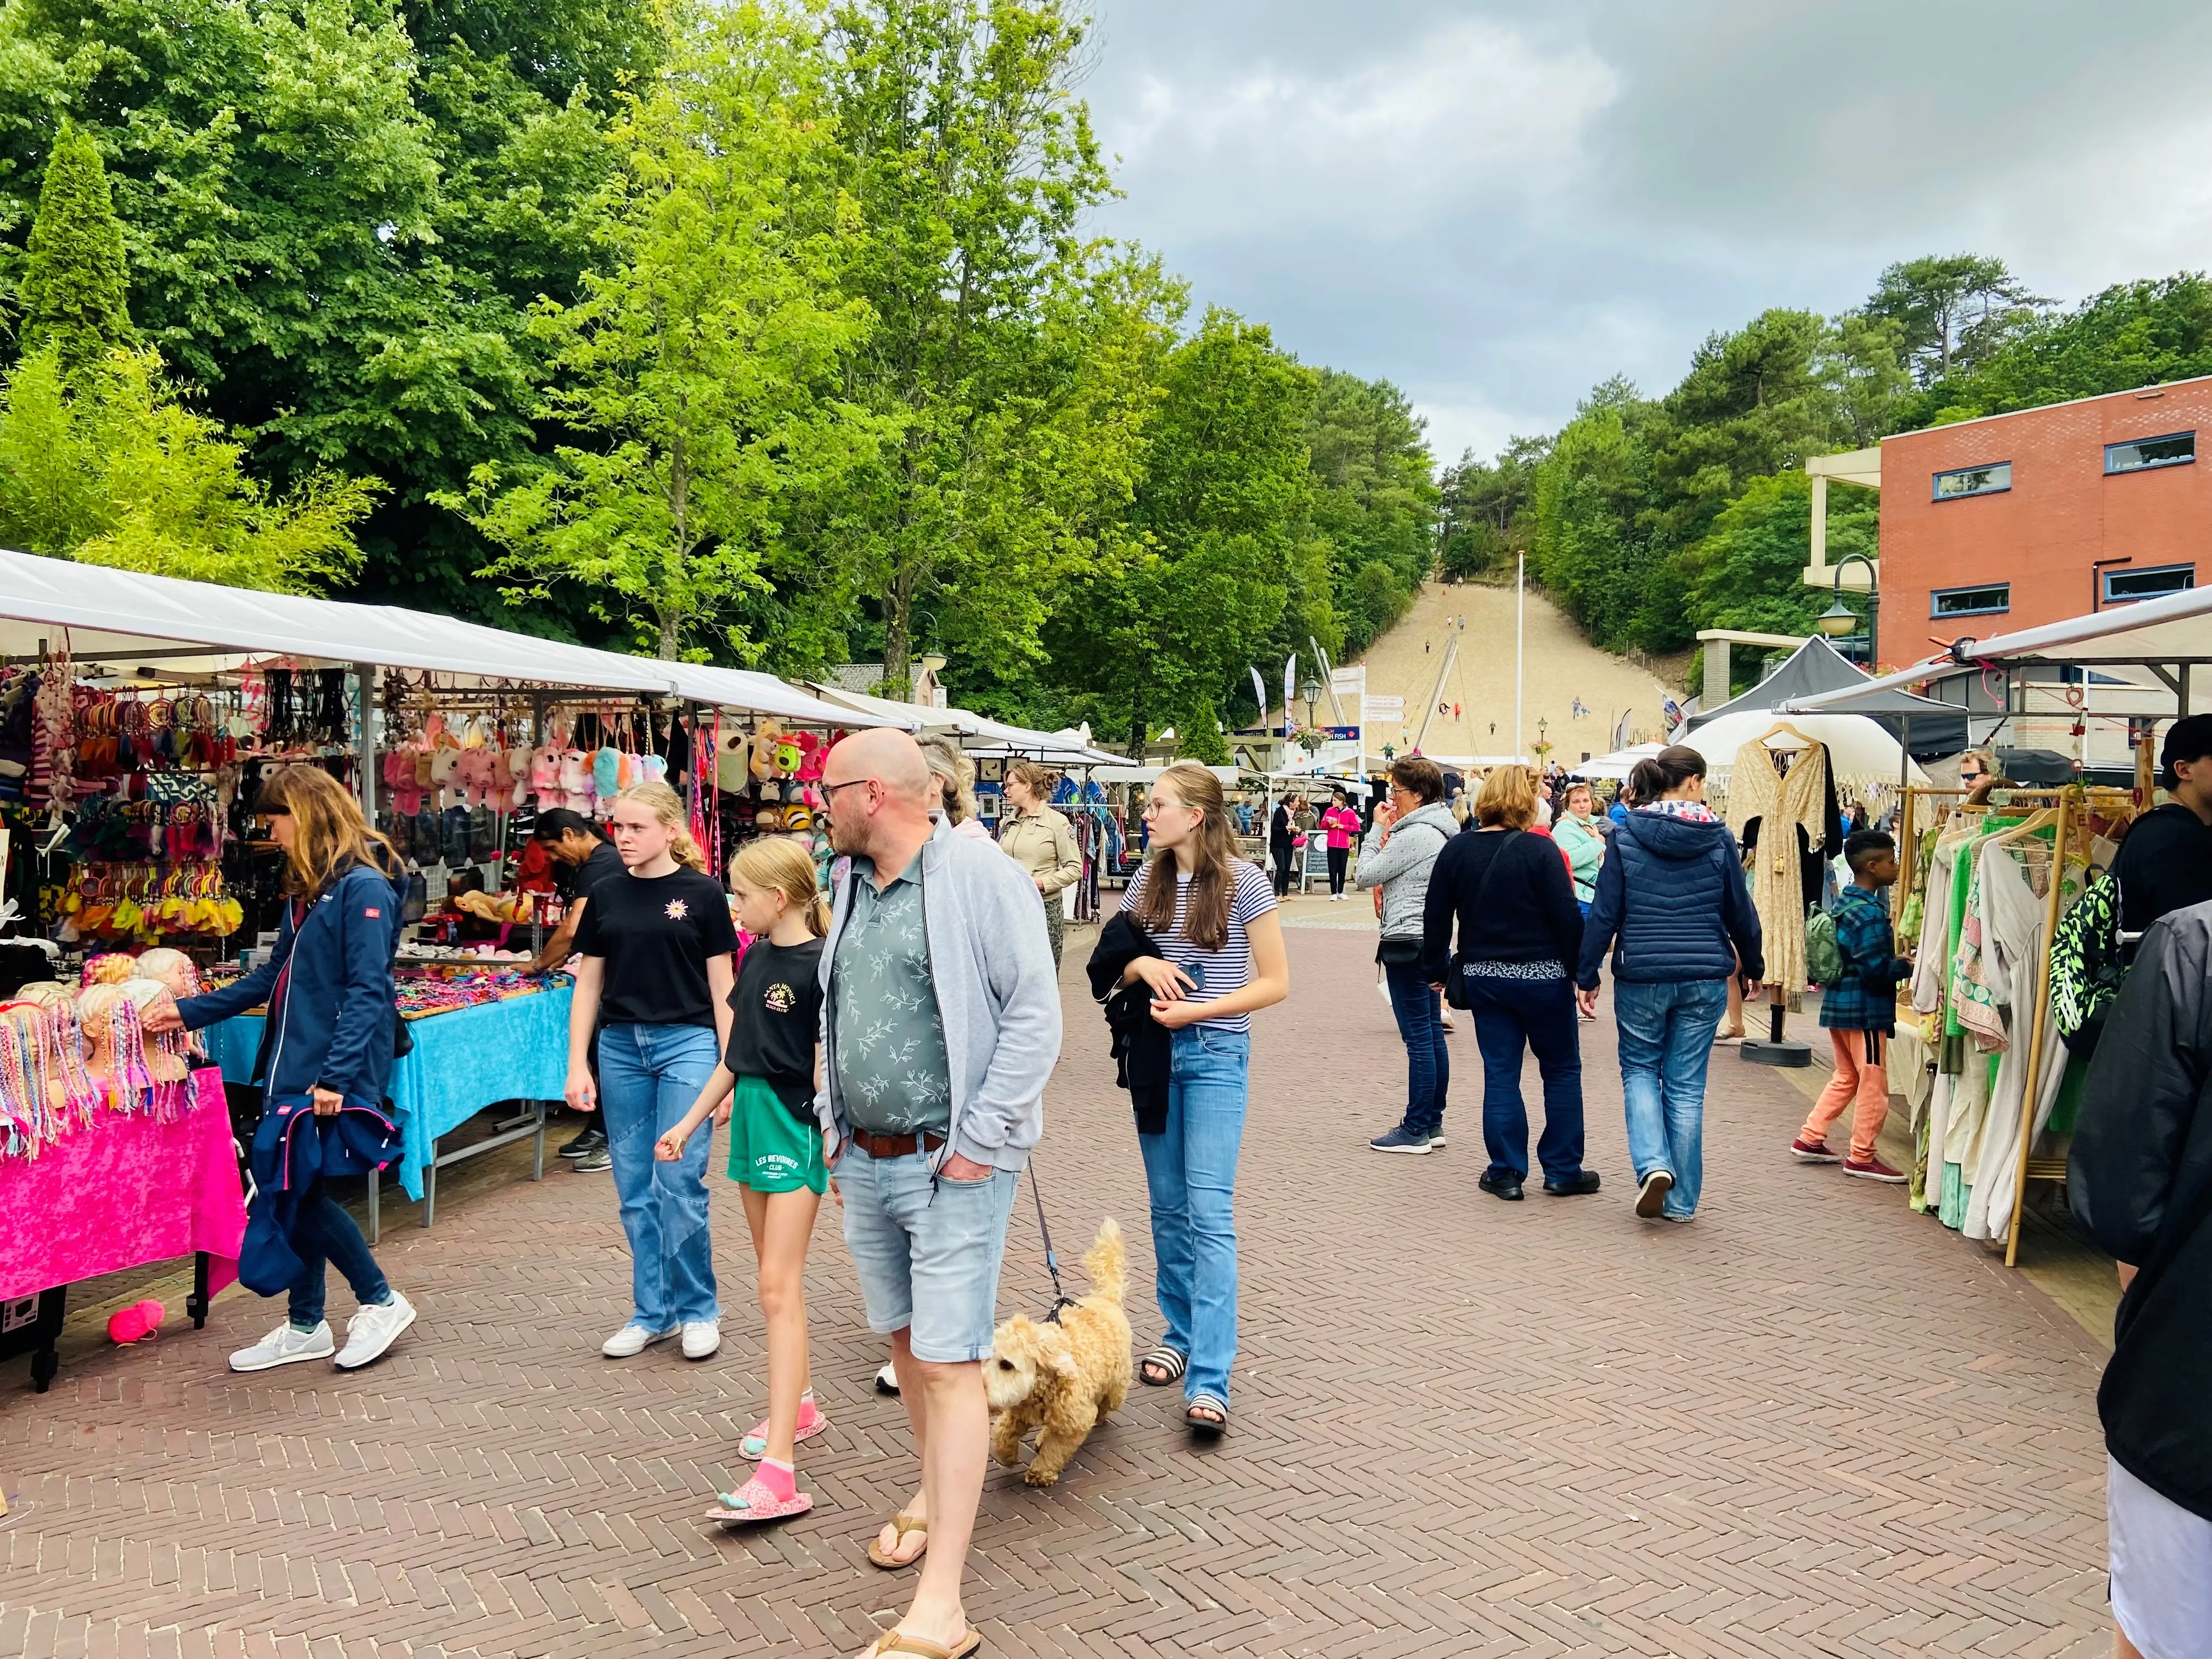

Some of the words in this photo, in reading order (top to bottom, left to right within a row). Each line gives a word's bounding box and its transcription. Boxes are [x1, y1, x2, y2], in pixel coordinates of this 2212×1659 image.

[764, 983, 780, 998] SANTA
[780, 983, 796, 1005] MONICA
[755, 1156, 767, 1167] LES
[768, 1154, 799, 1170] REVOIRES
